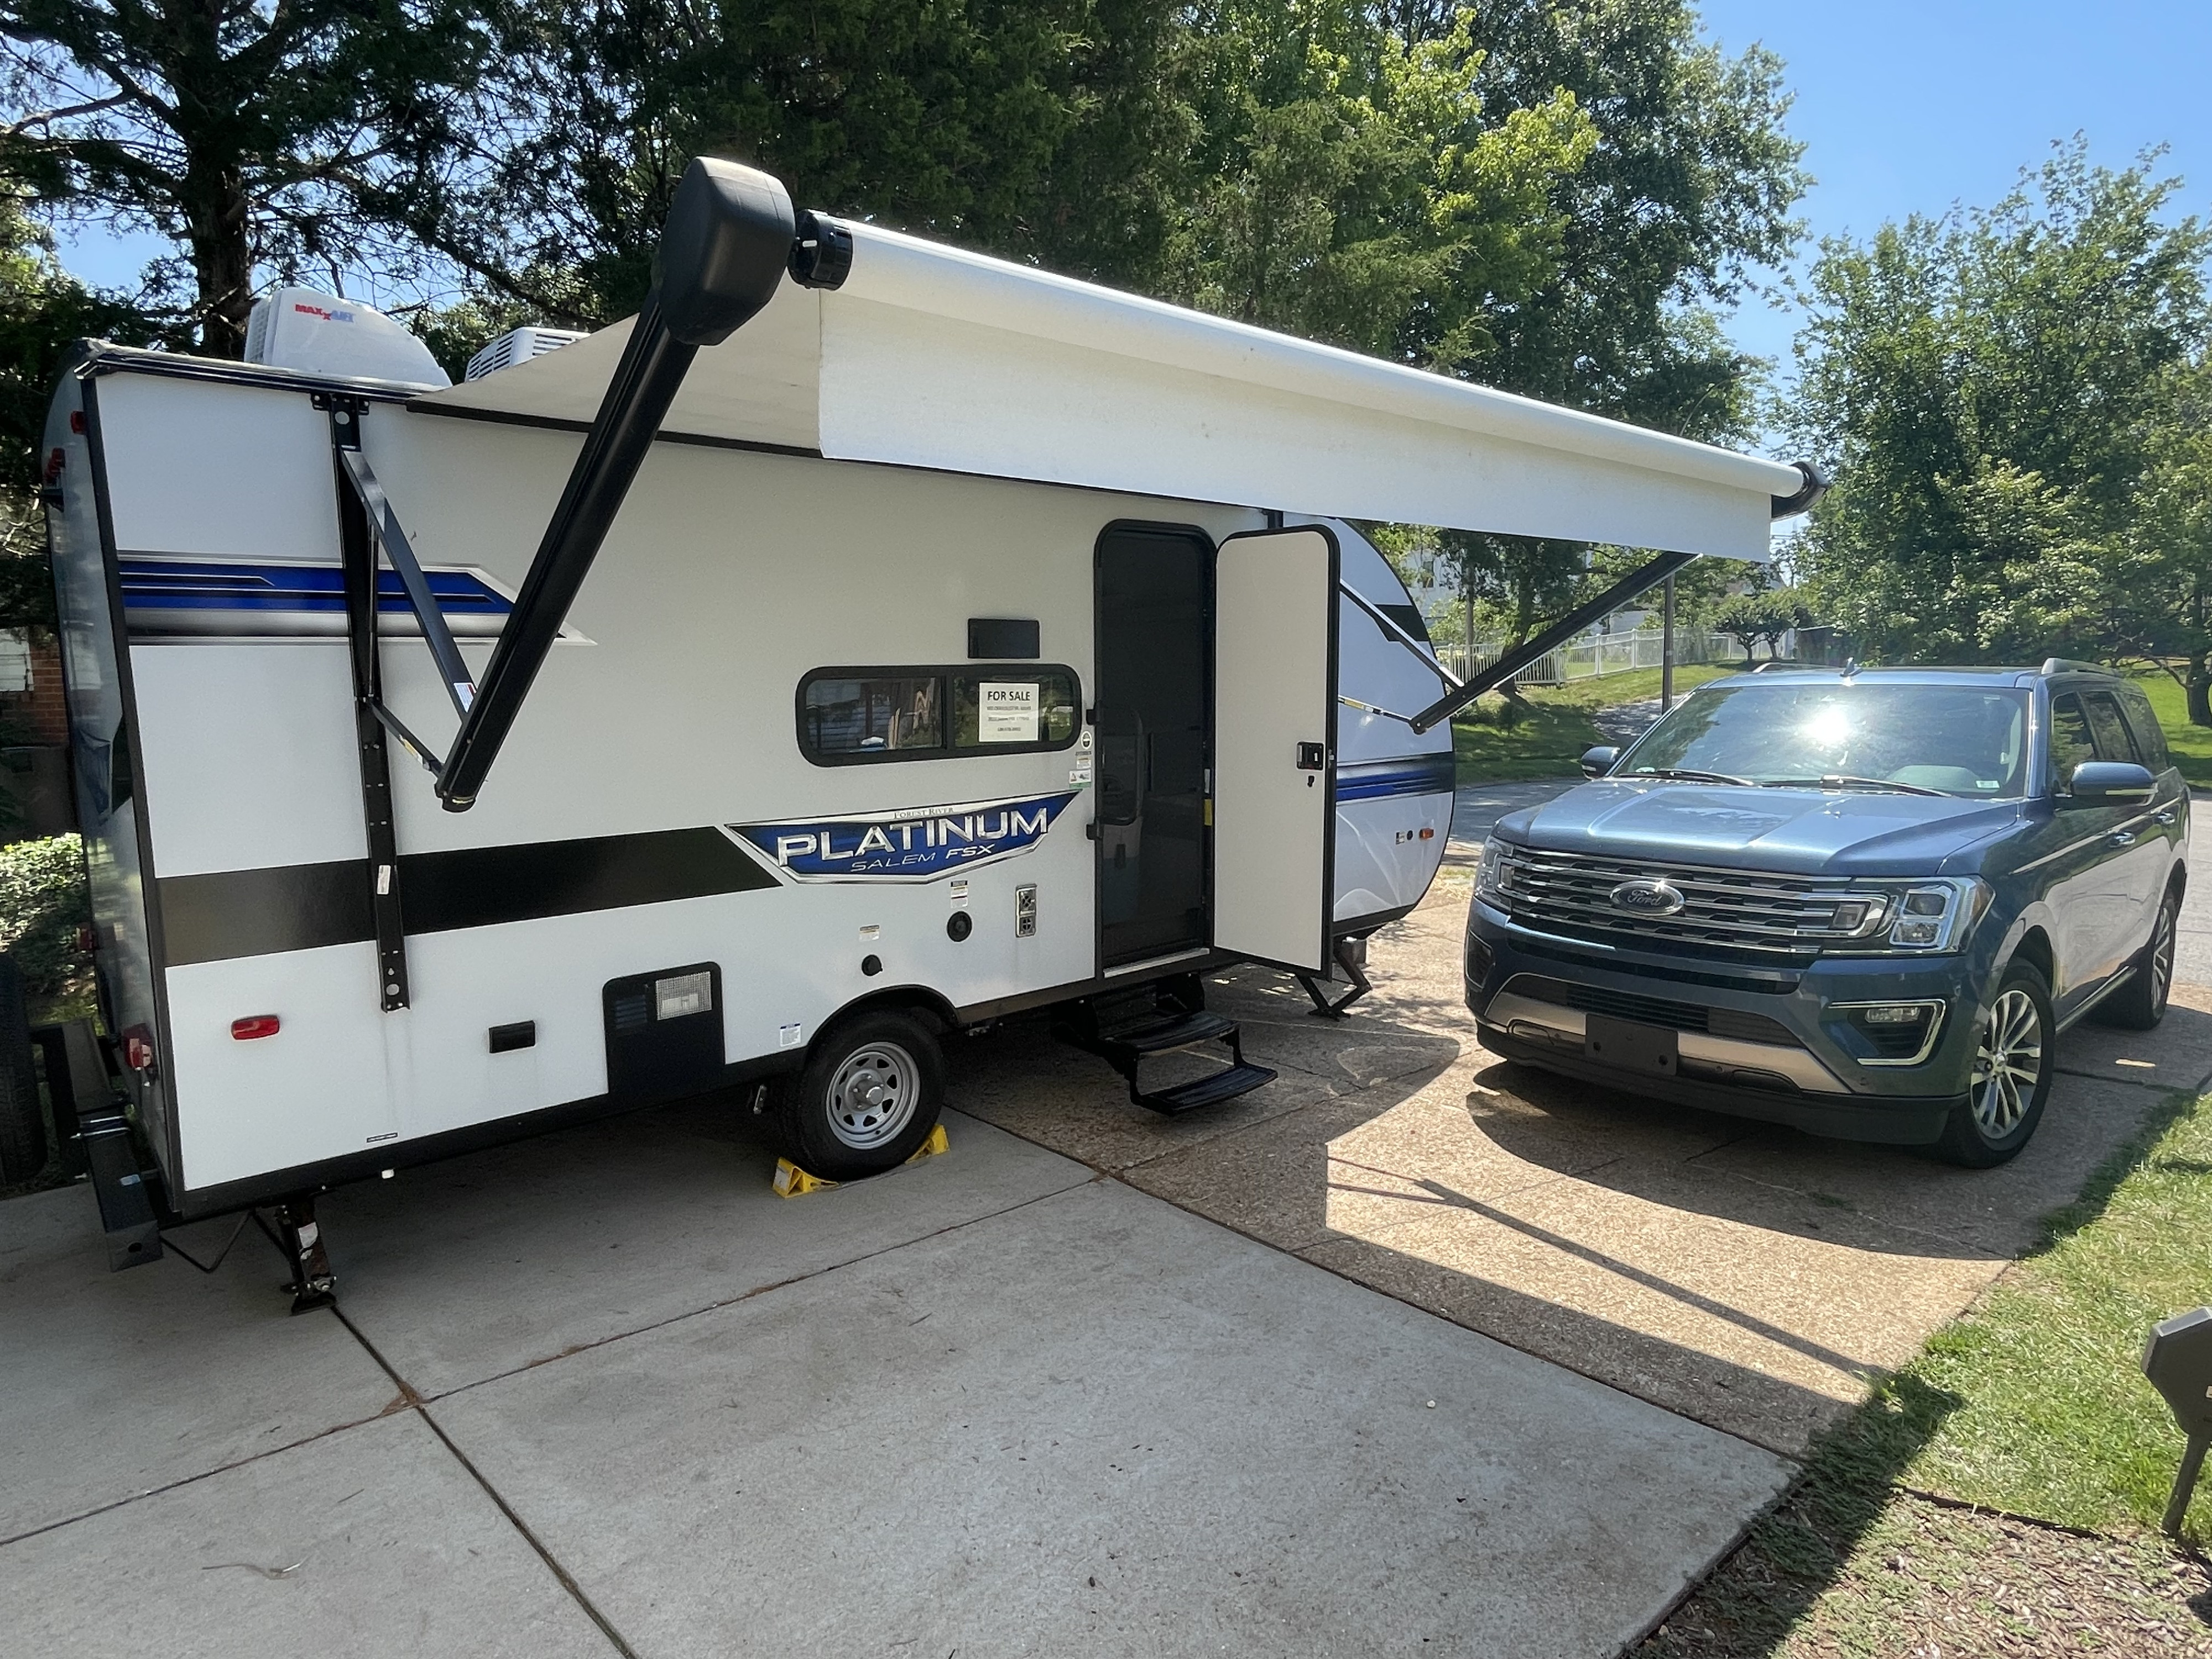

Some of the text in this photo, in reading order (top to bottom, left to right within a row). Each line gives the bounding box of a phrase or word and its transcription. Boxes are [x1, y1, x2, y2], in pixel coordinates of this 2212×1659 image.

[988, 691, 1031, 701] FOR SALE
[929, 807, 954, 816] RIVER
[778, 808, 1047, 867] PLATINUM
[850, 843, 995, 872] SALEM FSX
[1627, 889, 1662, 906] Ford
